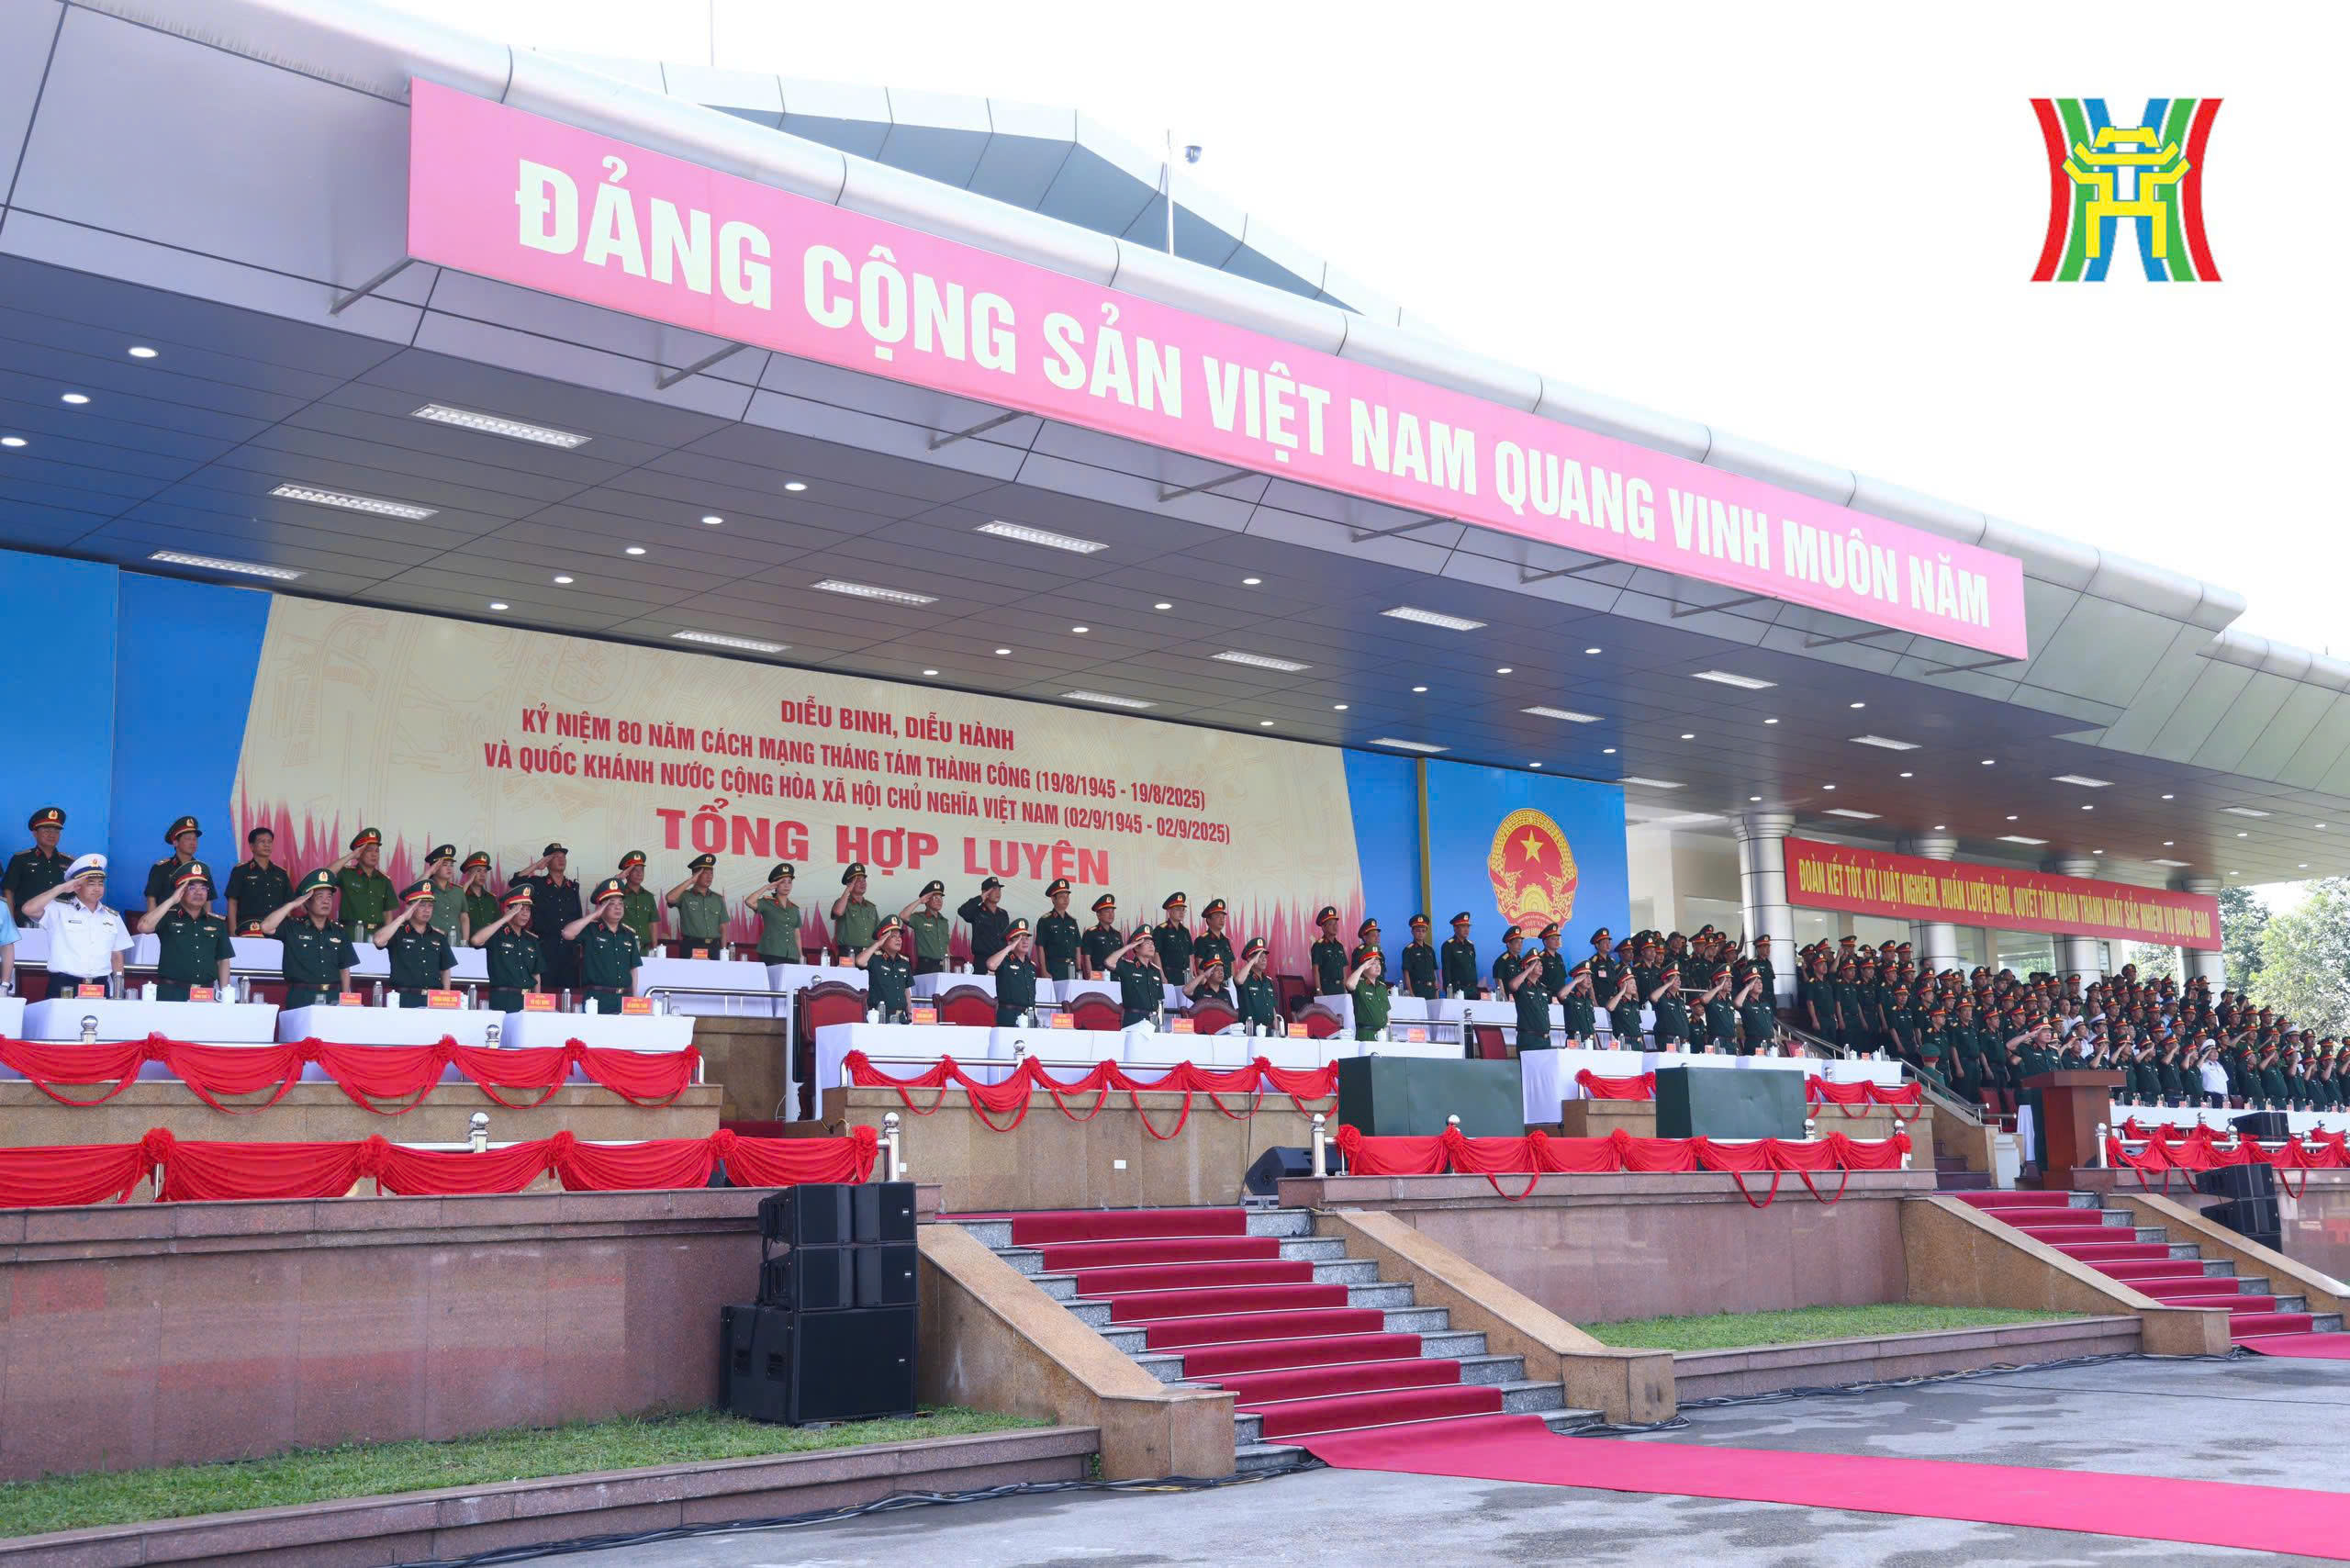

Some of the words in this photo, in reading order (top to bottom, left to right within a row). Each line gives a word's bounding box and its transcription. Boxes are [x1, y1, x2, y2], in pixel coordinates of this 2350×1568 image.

[515, 155, 771, 310] ĐẢNG
[803, 244, 1016, 375] CỘNG
[1043, 302, 1182, 419] SẢN
[1203, 361, 1330, 463] VIỆT
[1350, 398, 1477, 495] NAM
[1494, 441, 1655, 542] QUANG
[1667, 487, 1770, 571] VINH
[1783, 519, 1898, 603] MUÔN
[1908, 553, 1989, 628] NĂM
[522, 702, 550, 734] KỶ
[556, 711, 610, 745] NIỆM
[617, 720, 643, 745] 80
[648, 721, 695, 751] NĂM
[701, 727, 753, 758] CÁCH
[759, 737, 815, 767] MẠNG
[821, 743, 879, 772] THÁNG
[884, 749, 922, 777] TÁM
[926, 756, 981, 784] THÀNH
[986, 761, 1031, 790] CÔNG
[1035, 770, 1116, 800] (19/8/1945
[1131, 782, 1205, 812] 19/8/2025)
[781, 695, 833, 728] DIỄU
[839, 707, 899, 739] BINH,
[905, 711, 953, 744] DIỄU
[959, 722, 1014, 751] HÀNH
[484, 739, 512, 769] VÀ
[520, 742, 576, 777] QUỐC
[584, 752, 654, 784] KHÁNH
[661, 761, 715, 790] NƯỚC
[721, 766, 774, 799] CỘNG
[779, 771, 816, 801] HÒA
[822, 777, 846, 803] XÃ
[852, 780, 881, 812] HỘI
[887, 782, 922, 812] CHỦ
[926, 790, 979, 817] NGHĨA
[983, 794, 1017, 824] VIỆT
[1022, 801, 1058, 825] NAM
[1064, 806, 1143, 835] (02/9/1945
[1156, 816, 1231, 846] 02/9/2025)
[656, 797, 809, 862] TỔNG
[836, 825, 939, 876] HỢP
